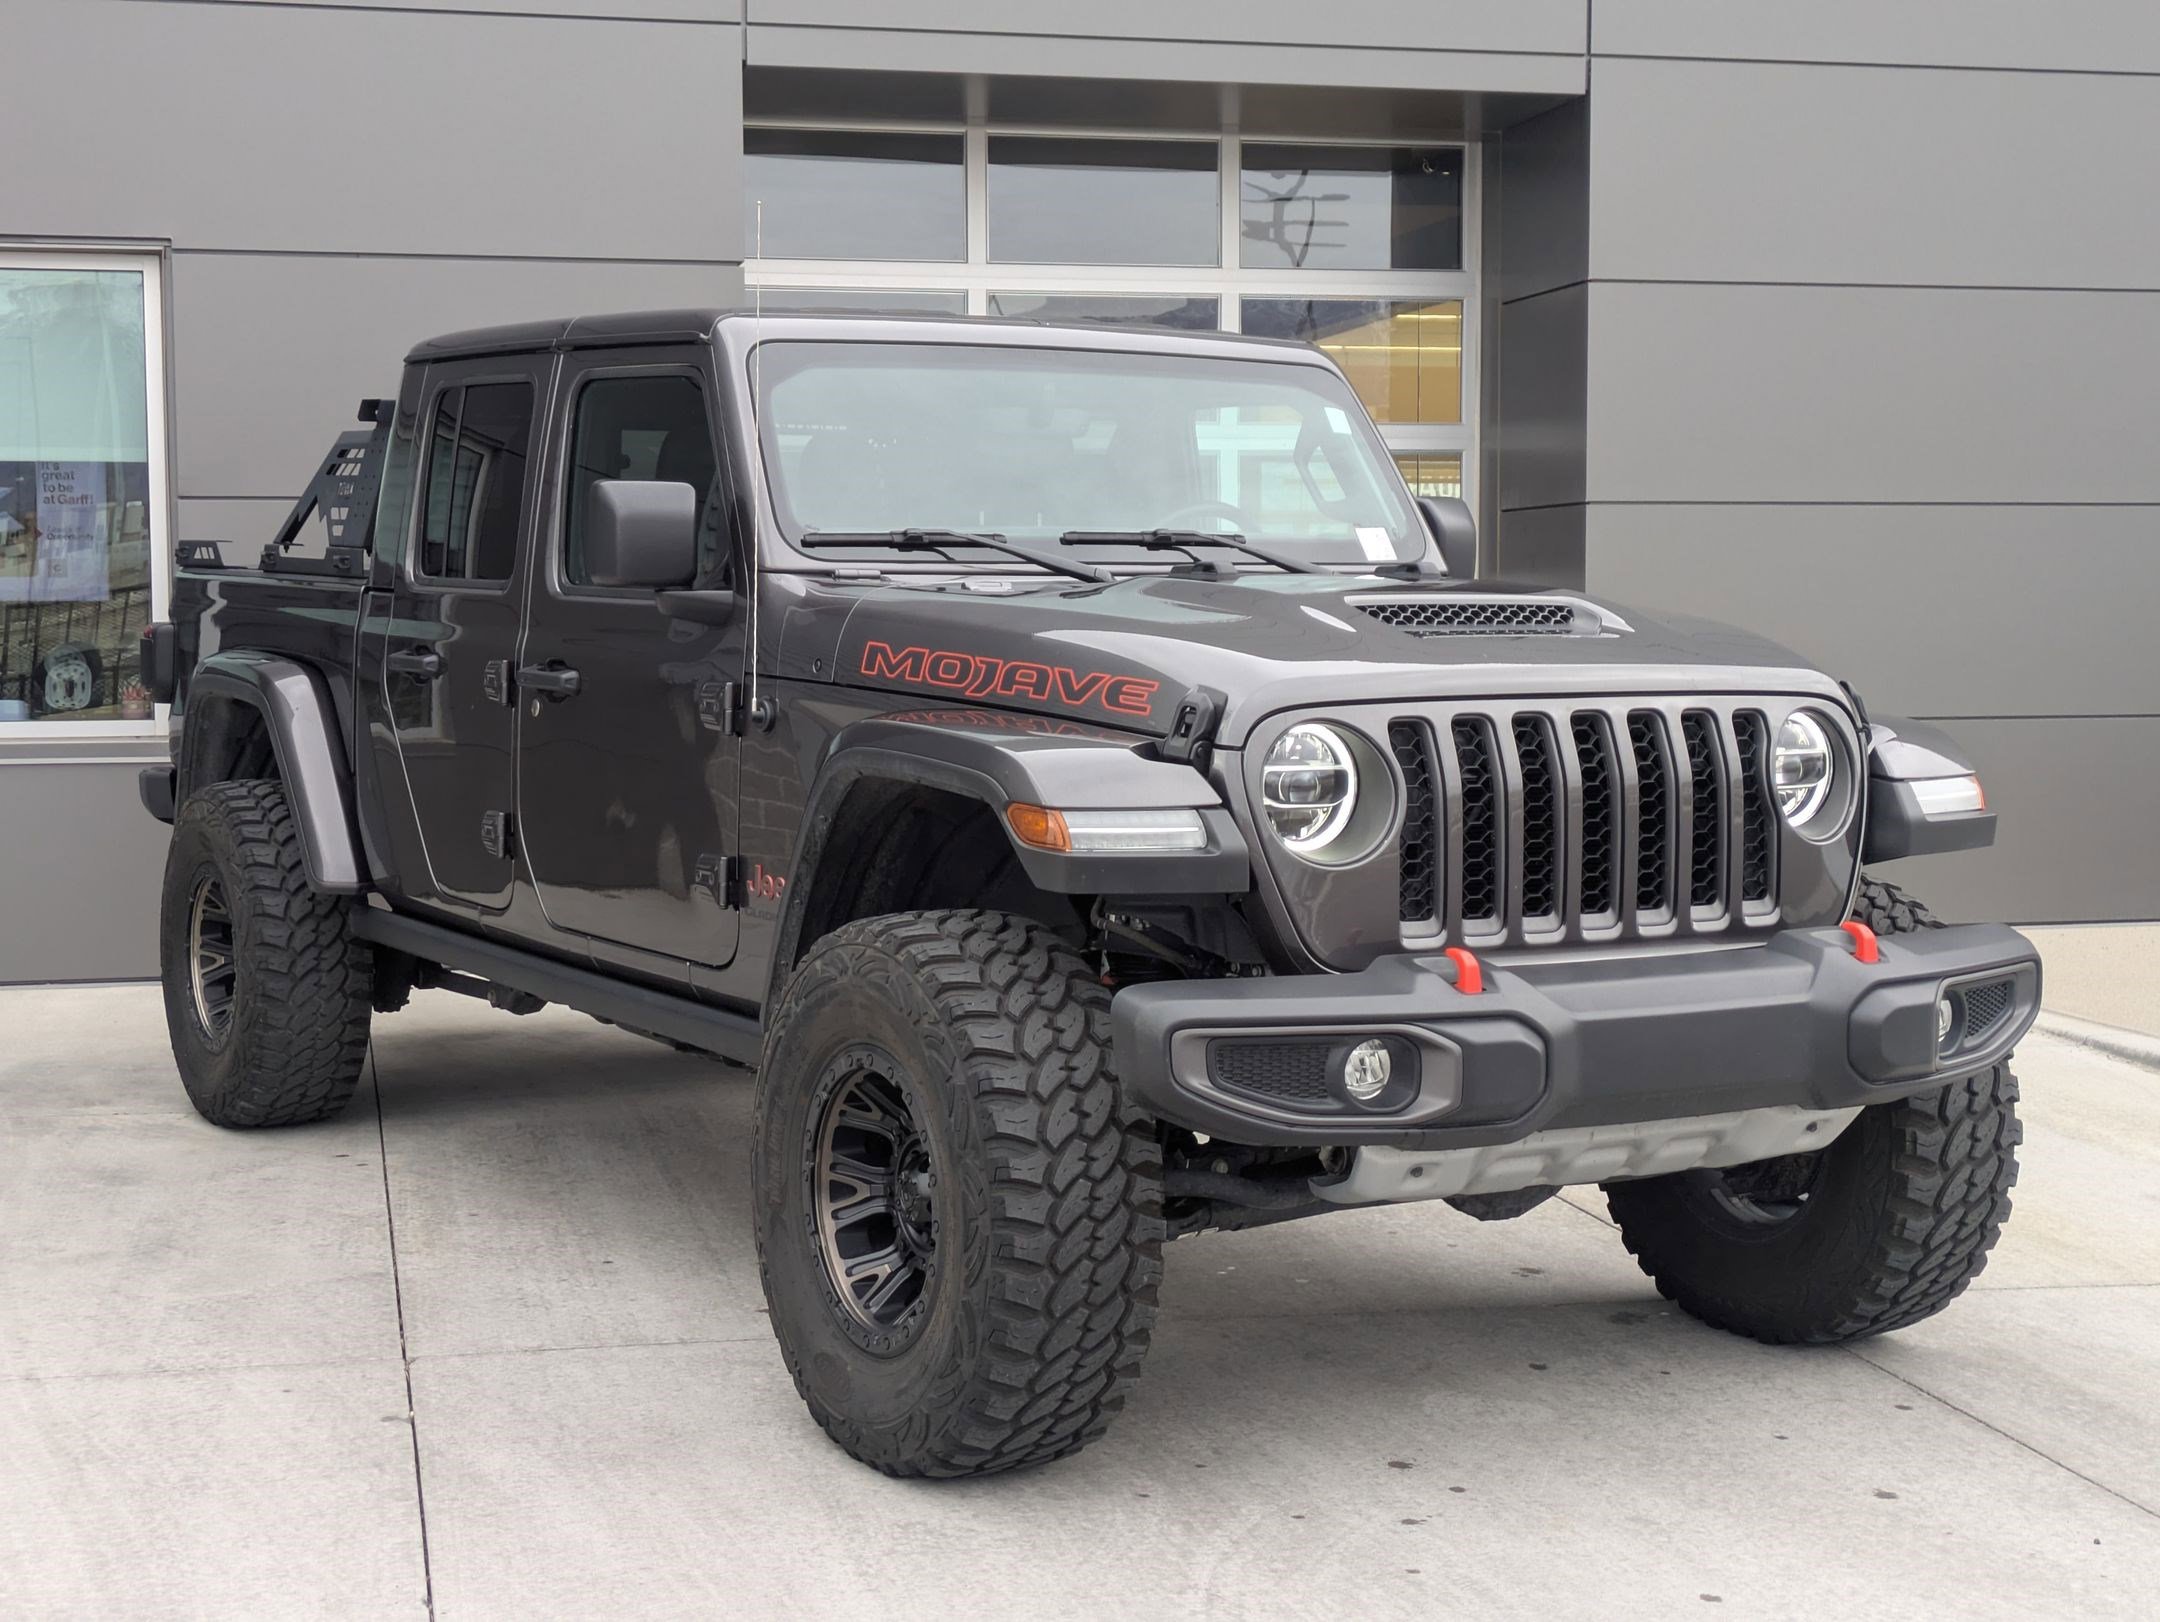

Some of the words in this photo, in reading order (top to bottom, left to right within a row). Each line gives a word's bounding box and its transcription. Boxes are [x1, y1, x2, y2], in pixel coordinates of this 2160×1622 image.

[41, 470, 75, 482] great
[43, 482, 56, 493] to
[58, 482, 74, 493] be
[43, 494, 56, 505] at
[57, 493, 94, 505] Garff!
[861, 641, 1160, 716] MOJAVE
